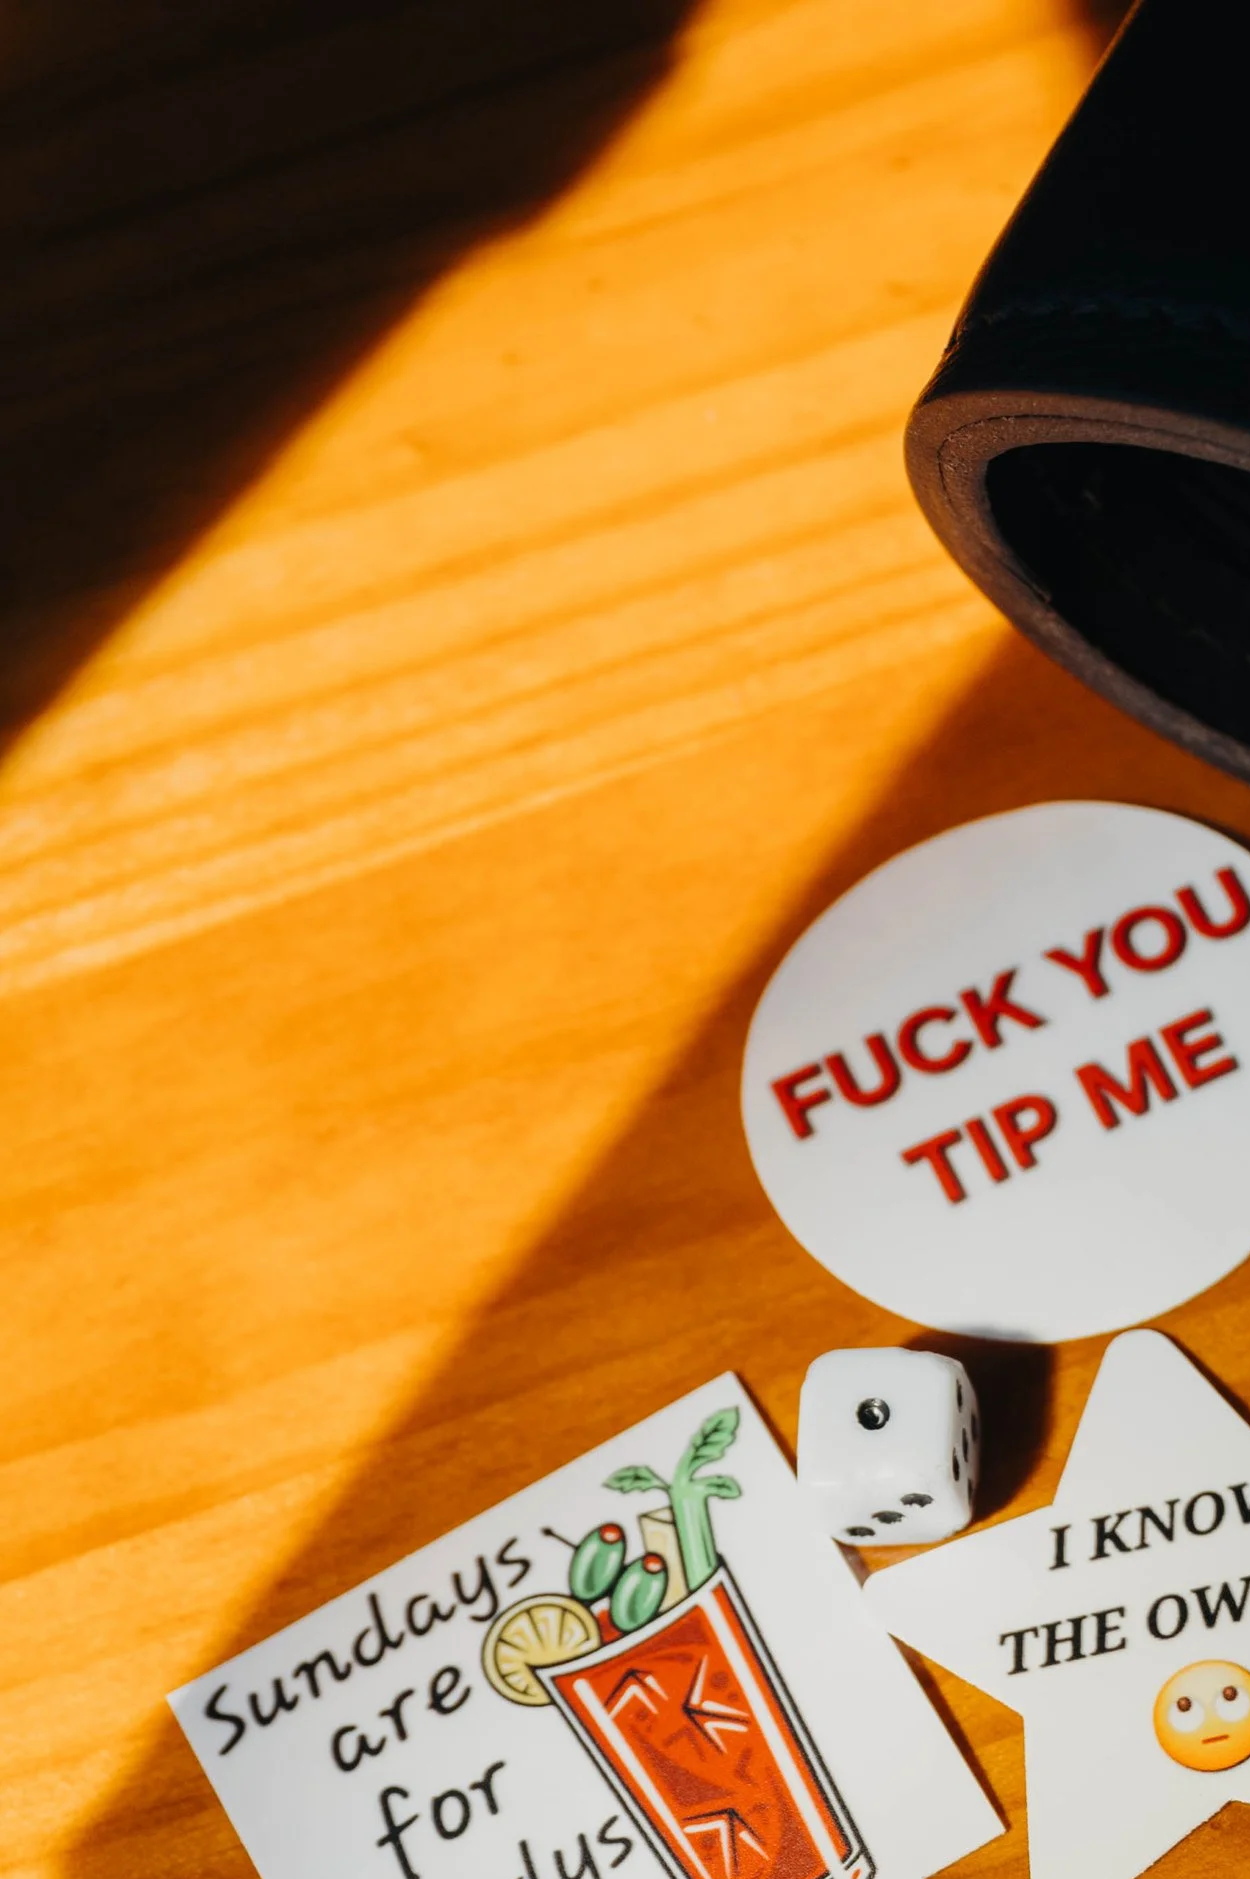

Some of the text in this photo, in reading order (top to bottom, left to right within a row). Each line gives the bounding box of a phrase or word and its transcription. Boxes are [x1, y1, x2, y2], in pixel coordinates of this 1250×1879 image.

[769, 967, 1048, 1140] FUCK
[900, 1009, 1240, 1205] TIP ME
[1048, 1524, 1073, 1570] I
[200, 1537, 533, 1756] Sundays
[998, 1605, 1128, 1676] THE
[330, 1663, 472, 1773] are
